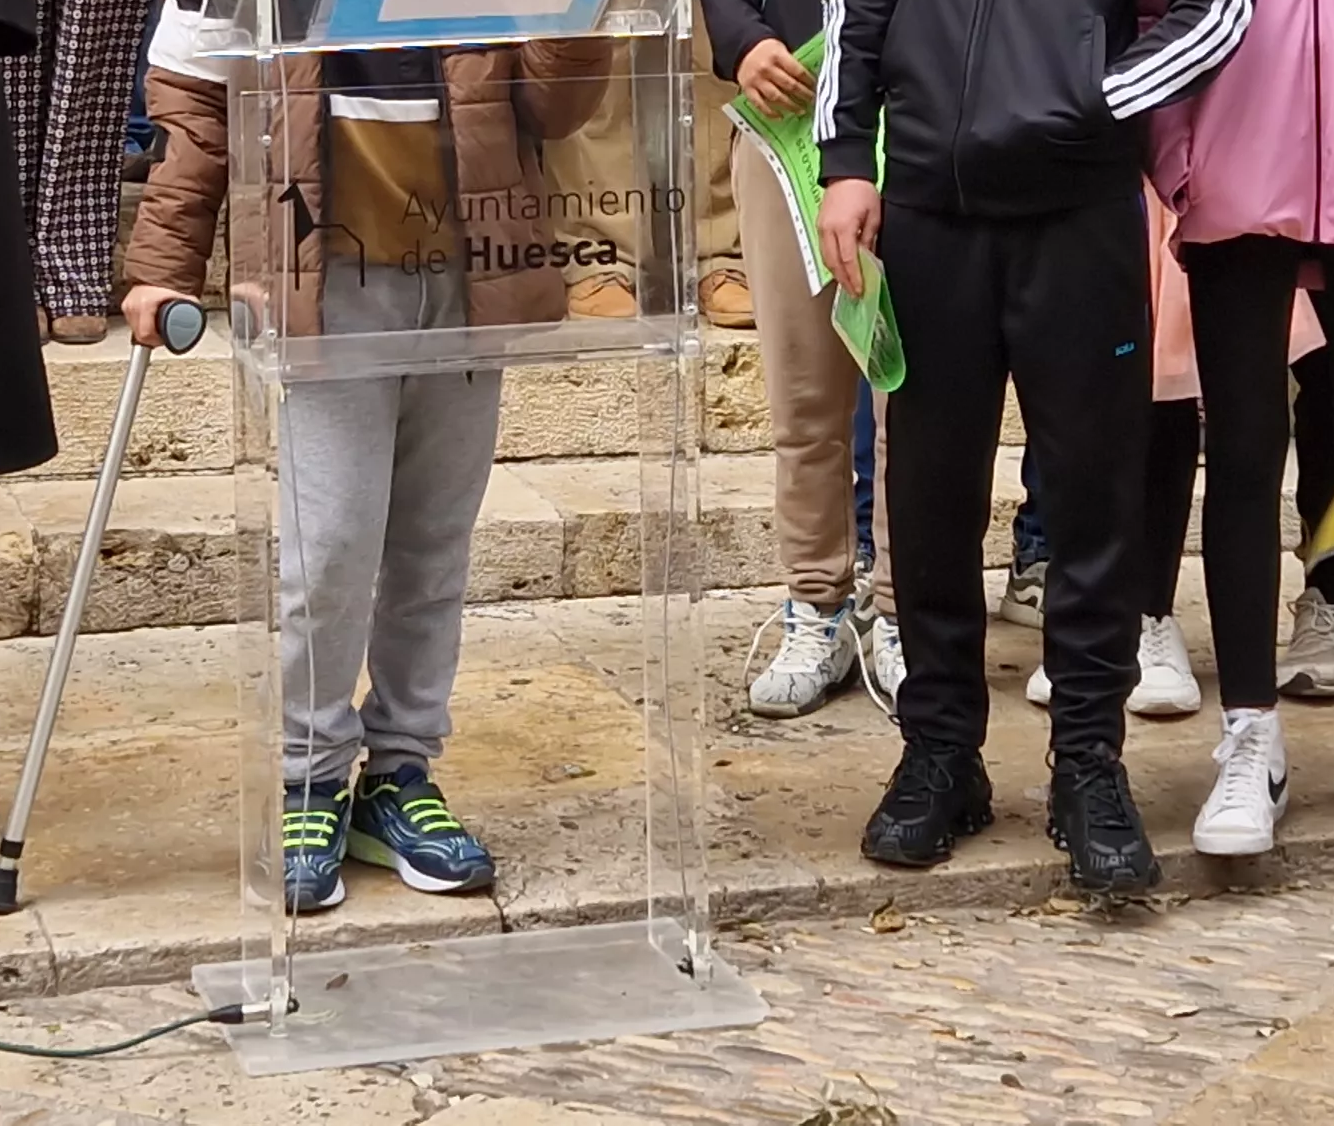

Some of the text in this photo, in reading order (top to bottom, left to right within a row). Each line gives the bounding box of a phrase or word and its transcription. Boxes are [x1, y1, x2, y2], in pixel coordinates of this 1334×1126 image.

[401, 180, 686, 236] Ayuntamiento
[401, 234, 619, 276] de Huesca
